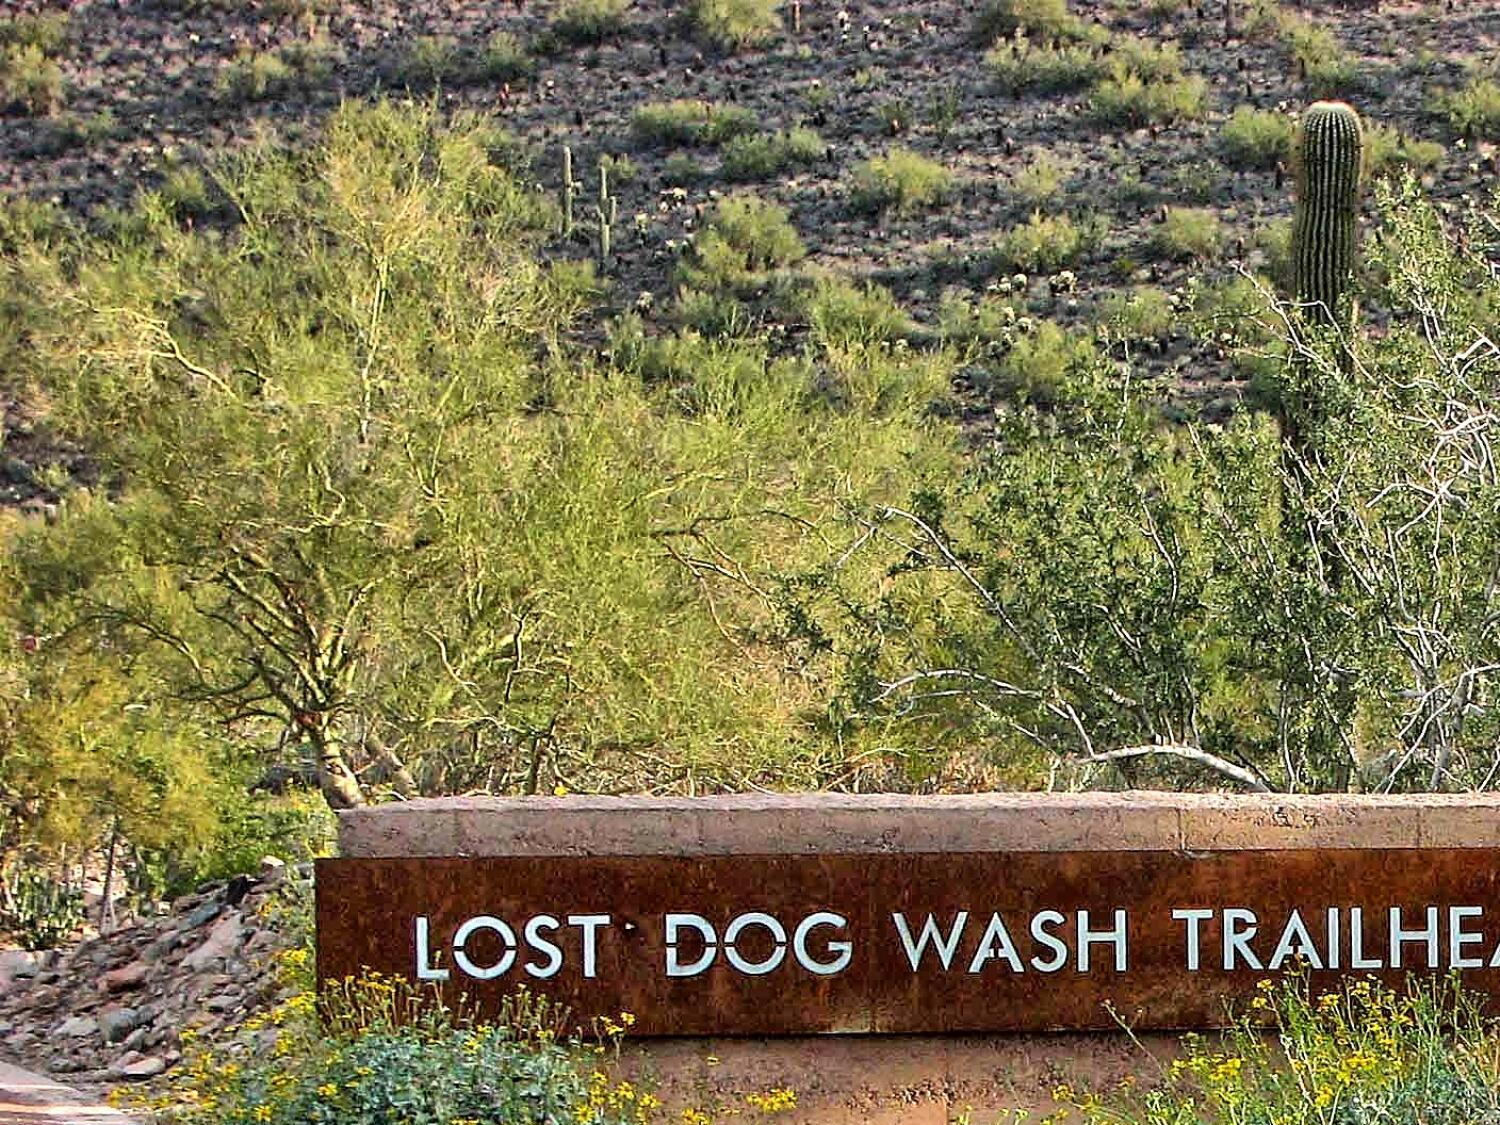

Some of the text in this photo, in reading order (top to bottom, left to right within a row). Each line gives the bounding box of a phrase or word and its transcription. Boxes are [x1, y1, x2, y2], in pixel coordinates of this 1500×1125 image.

[415, 913, 611, 980] LOST
[665, 912, 853, 976] DOG
[893, 909, 1127, 973] WASH
